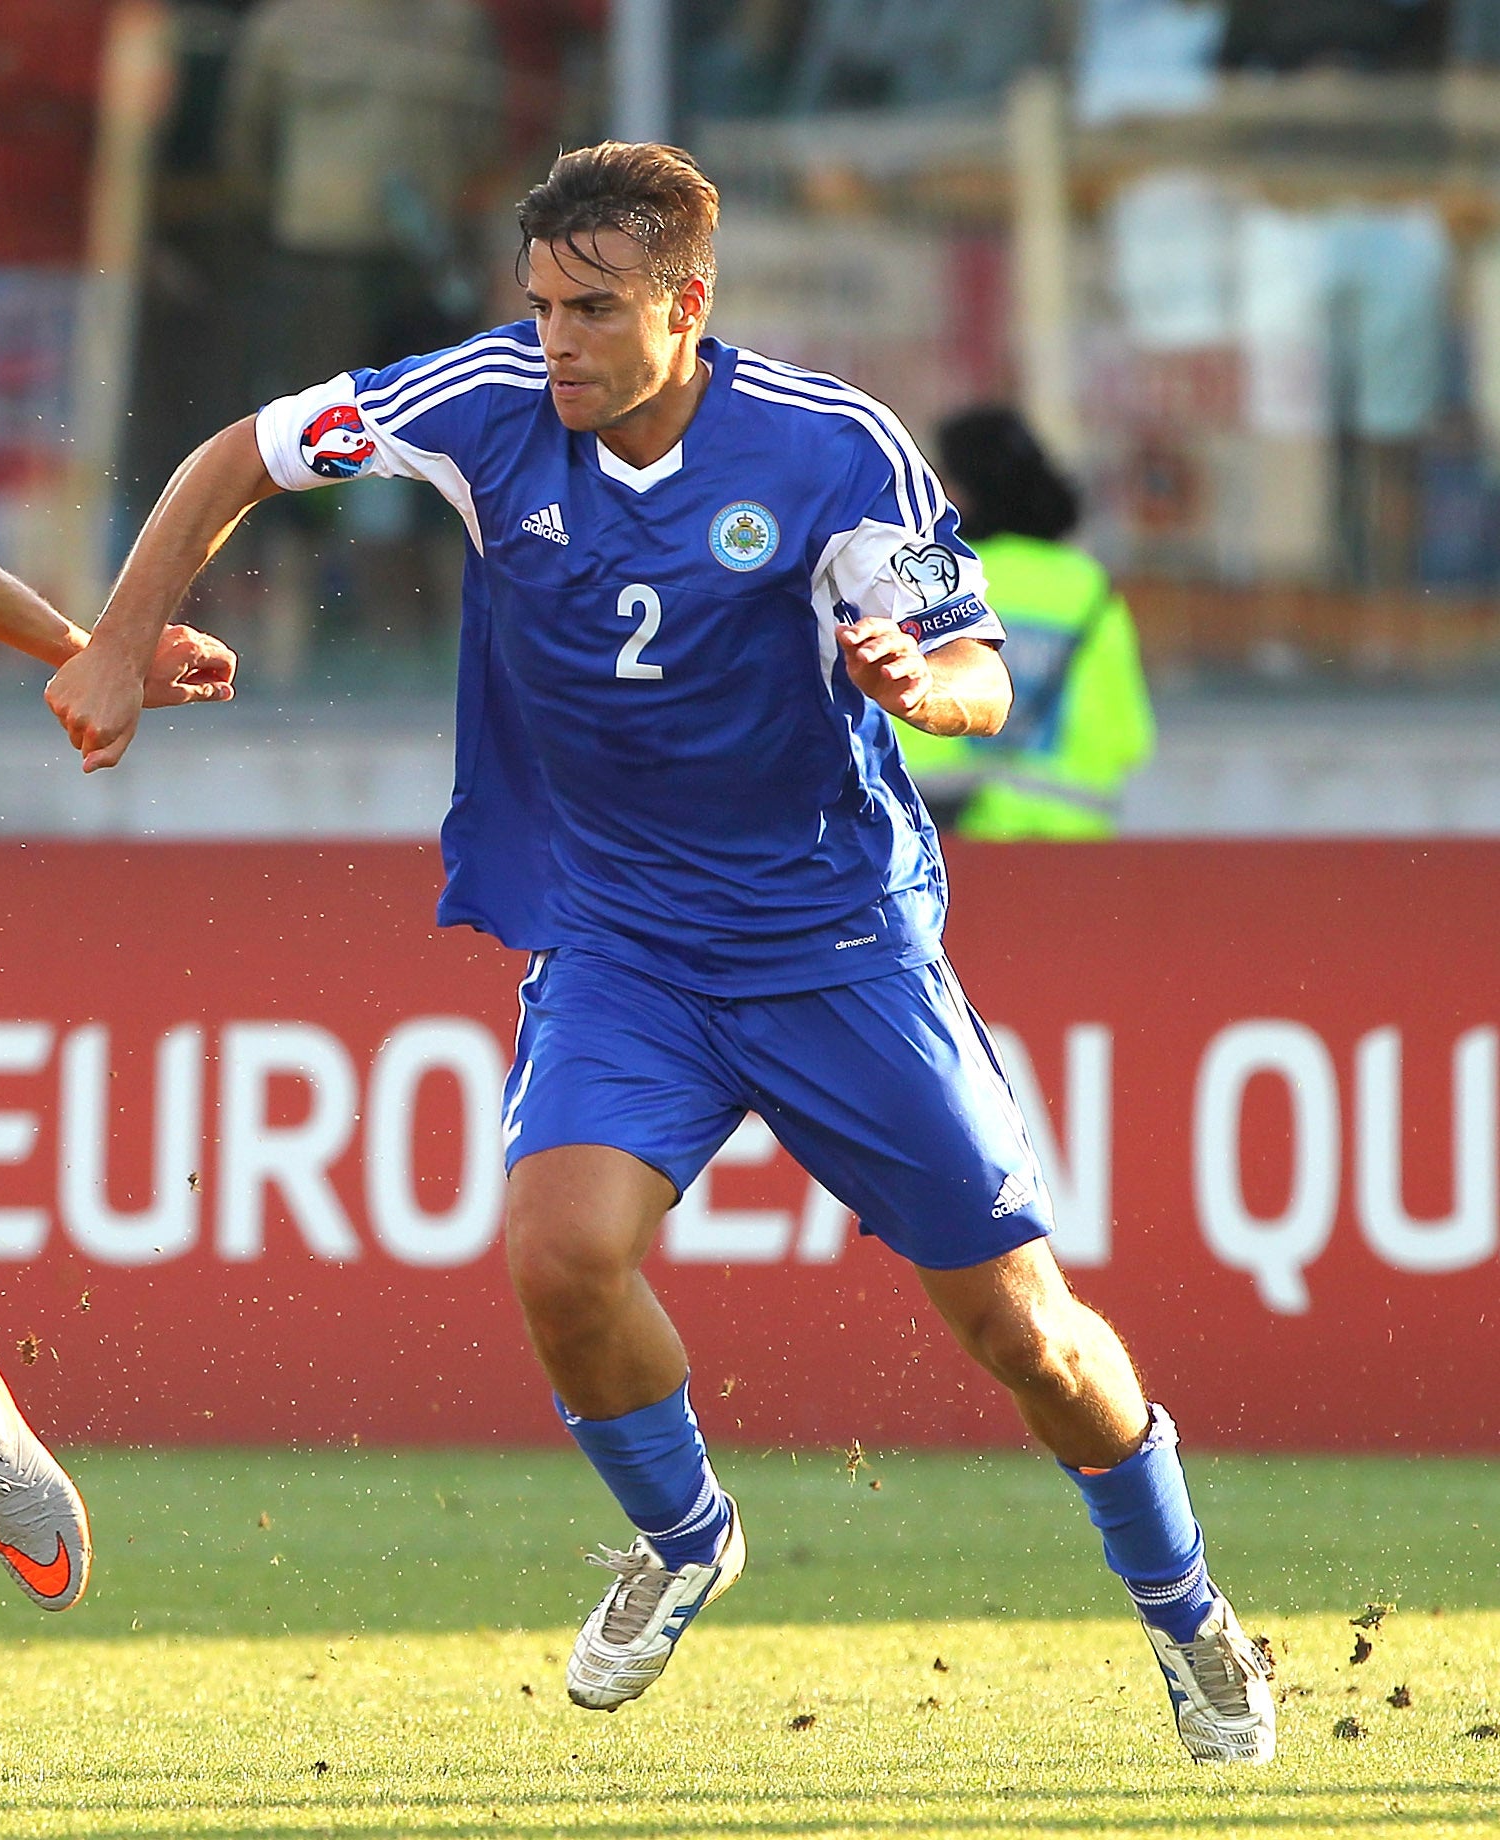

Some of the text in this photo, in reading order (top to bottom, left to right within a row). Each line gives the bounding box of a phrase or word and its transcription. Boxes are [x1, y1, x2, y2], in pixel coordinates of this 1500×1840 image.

[521, 519, 570, 546] adidas
[615, 583, 663, 679] 2
[1190, 1017, 1500, 1315] QU
